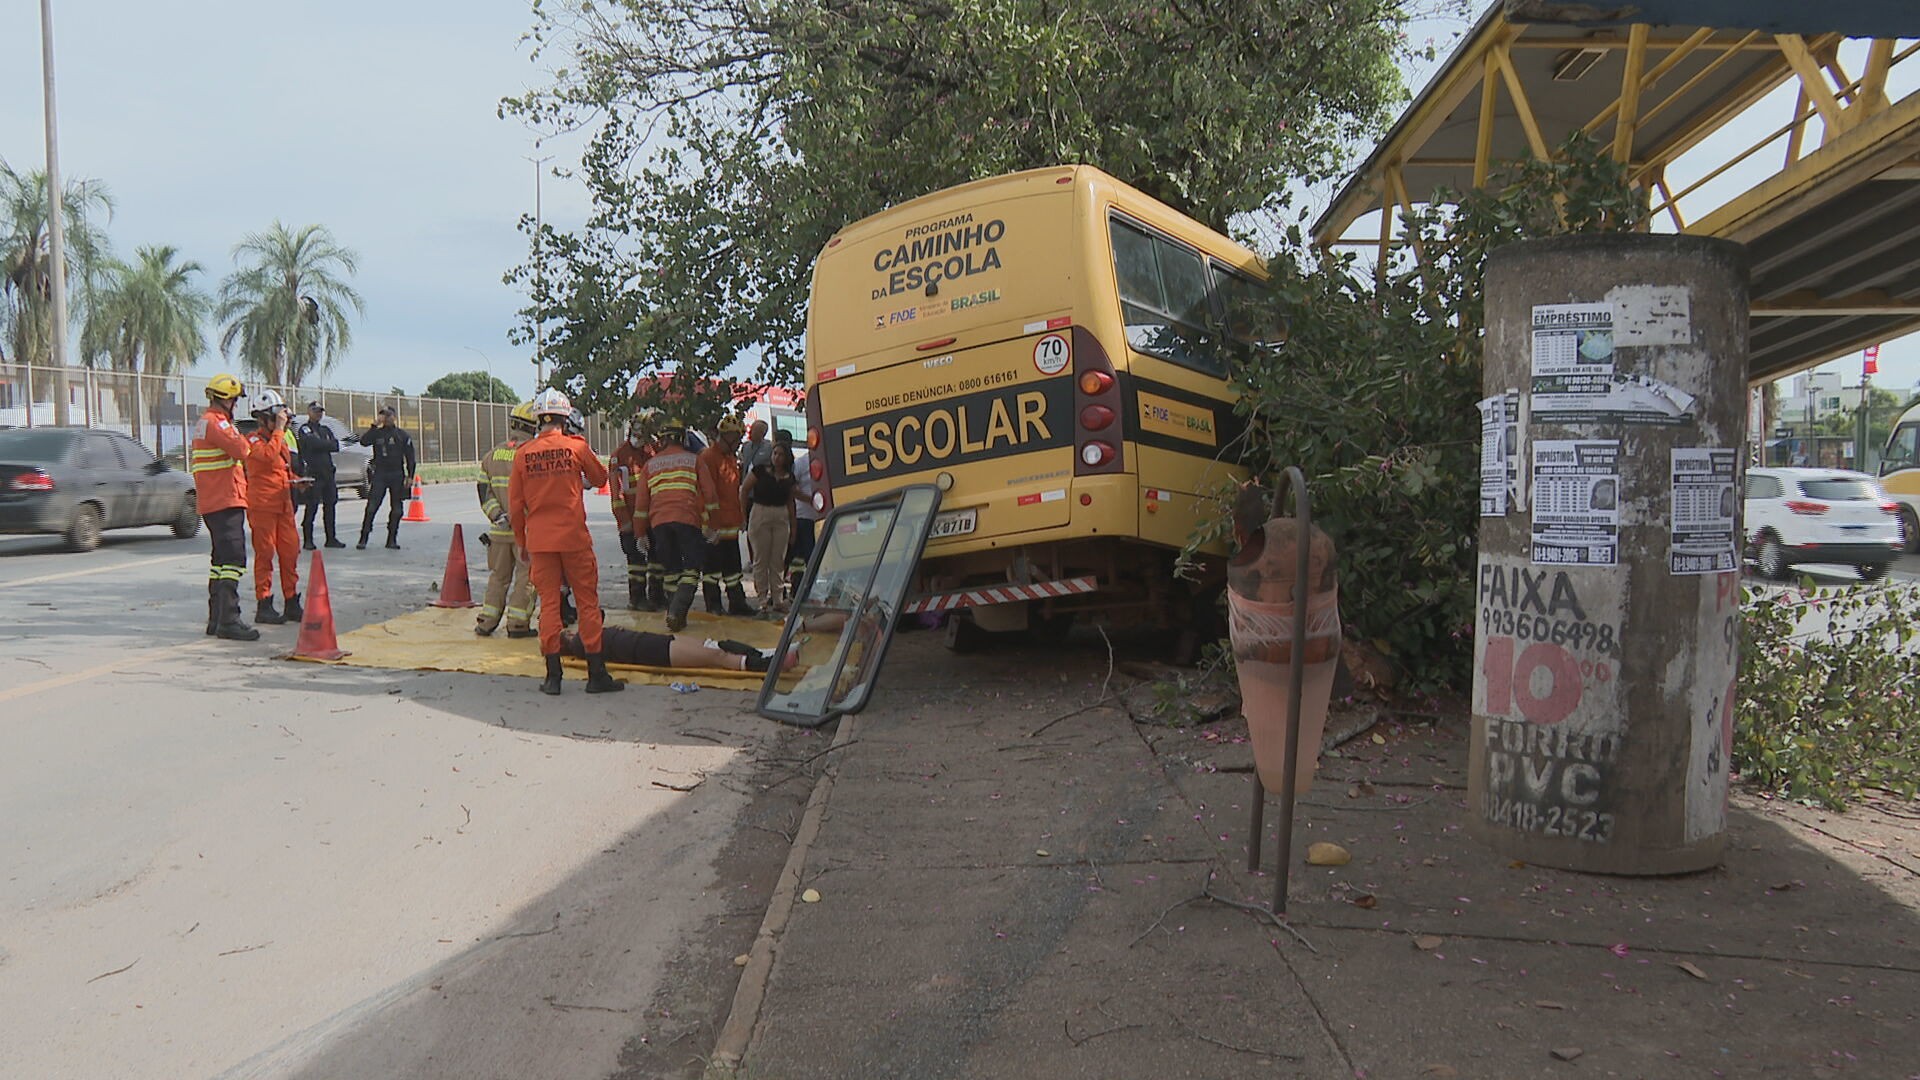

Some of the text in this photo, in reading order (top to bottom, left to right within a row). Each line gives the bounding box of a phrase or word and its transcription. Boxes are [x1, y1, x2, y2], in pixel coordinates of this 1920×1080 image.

[873, 219, 1005, 272] CAMINHO
[905, 213, 974, 239] PROGRAMA
[871, 247, 1002, 301] DA ESCOLA
[889, 307, 916, 325] FNDE
[950, 288, 1001, 312] BRASIL
[1534, 309, 1612, 325] EMPRÉSTIMO
[923, 355, 953, 369] IVECO
[1040, 338, 1063, 358] 70
[865, 369, 1018, 411] DISQUE DENÚNCIA: 0800 616161
[843, 390, 1051, 477] ESCOLAR
[1186, 416, 1213, 433] BRASIL
[525, 448, 573, 464] BOMBEIRO
[525, 459, 573, 473] MILITAR
[1480, 563, 1587, 621] FAIXA
[1482, 607, 1614, 654] 993606498
[1483, 636, 1582, 725] 10
[1489, 751, 1601, 804] PVC
